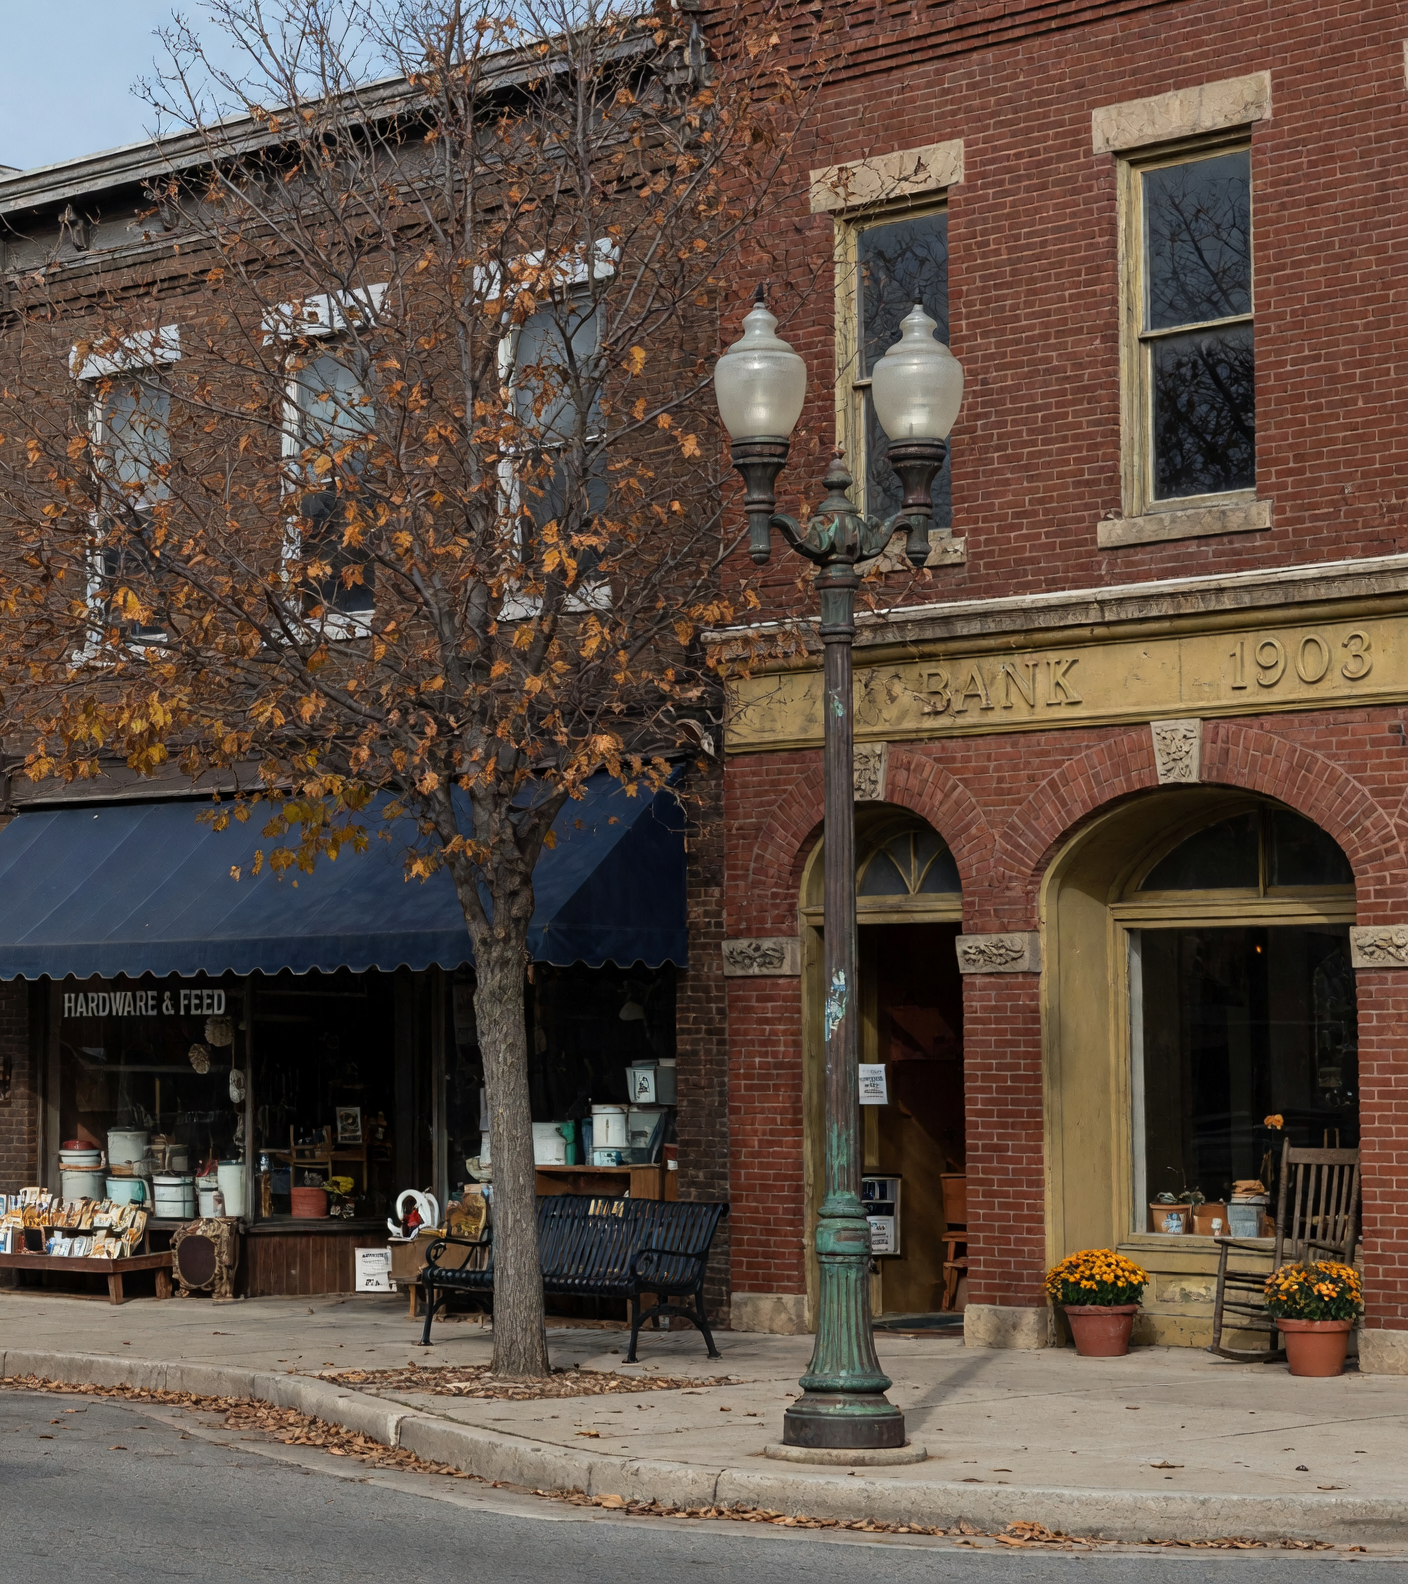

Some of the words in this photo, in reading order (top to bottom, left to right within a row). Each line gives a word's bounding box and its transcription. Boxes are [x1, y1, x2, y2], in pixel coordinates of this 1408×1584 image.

[919, 657, 1084, 716] BANK
[1229, 630, 1373, 691] 1903
[63, 990, 158, 1018] HARDWARE
[162, 991, 175, 1016] &
[180, 989, 226, 1016] FEED
